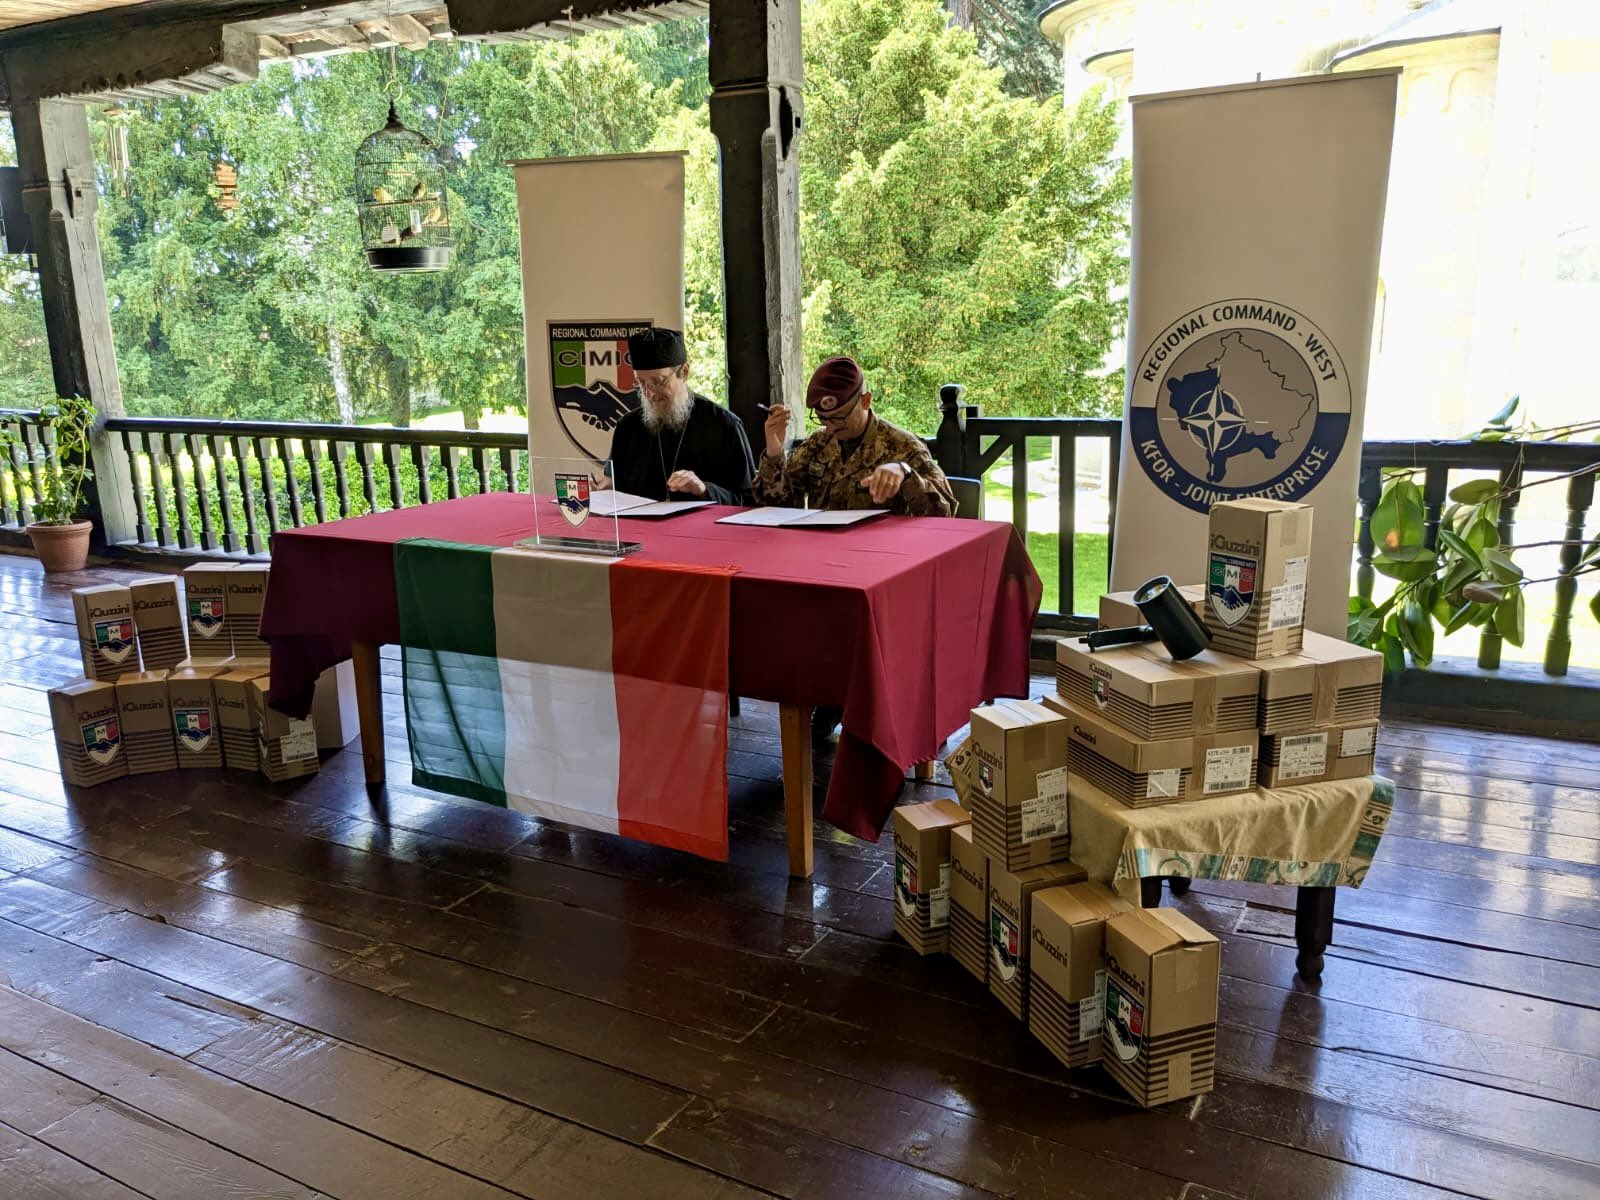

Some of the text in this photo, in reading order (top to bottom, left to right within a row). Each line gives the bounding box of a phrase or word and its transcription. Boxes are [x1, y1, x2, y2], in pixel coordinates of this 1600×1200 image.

[552, 327, 589, 338] REGIONAL
[590, 327, 628, 338] COMMAND
[1142, 314, 1209, 382] REGIONAL
[1213, 304, 1297, 332] COMMAND
[1304, 333, 1337, 382] WEST
[1140, 439, 1175, 484] KFOR
[1210, 533, 1260, 556] iGuzzini
[1032, 926, 1068, 969] iGuzzini
